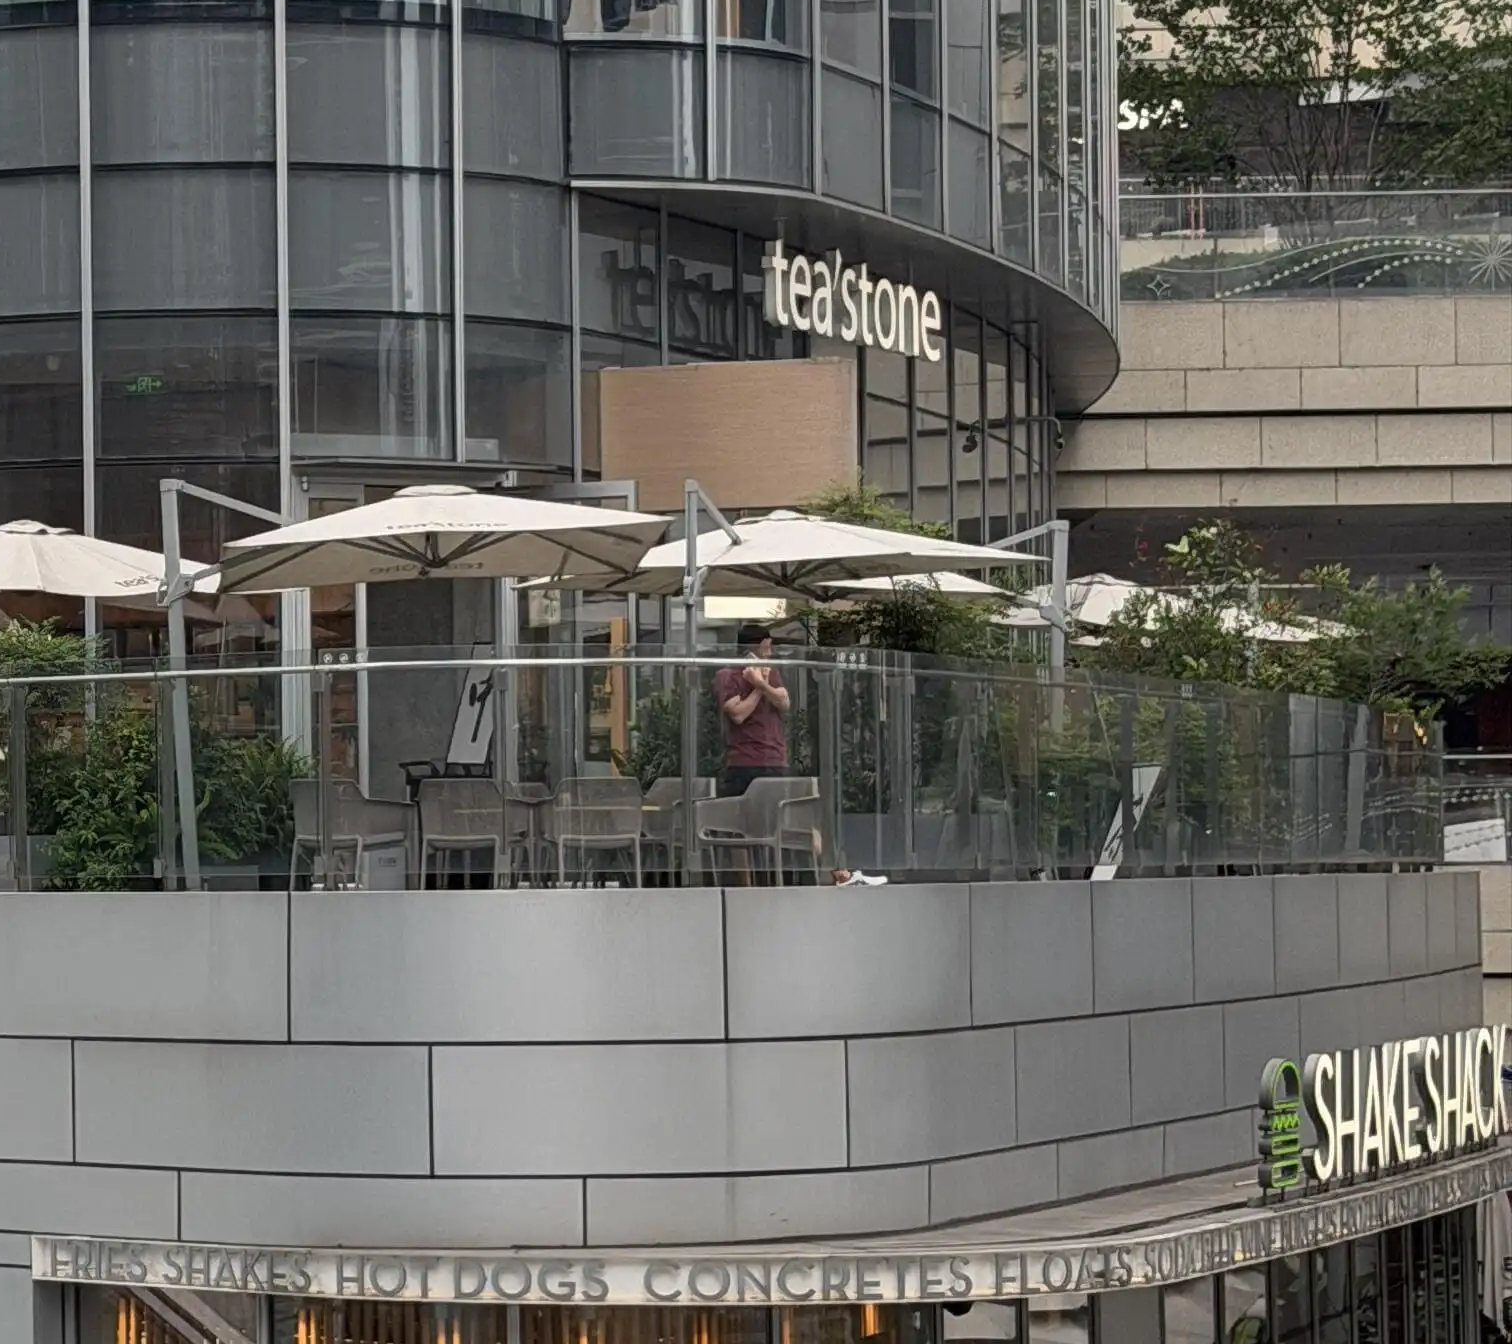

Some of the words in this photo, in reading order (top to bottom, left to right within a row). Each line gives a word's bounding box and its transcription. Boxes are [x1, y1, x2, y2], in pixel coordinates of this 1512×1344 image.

[762, 238, 942, 362] tea'stone
[1310, 1039, 1422, 1182] SHAKE
[1424, 1023, 1511, 1154] SHACK
[50, 1238, 147, 1282] FRIES
[161, 1246, 312, 1293] SHAKES
[336, 1255, 440, 1298] HOT
[453, 1258, 609, 1302] DOGS
[642, 1255, 974, 1303] CONCRETES
[994, 1244, 1135, 1297] FLOATS
